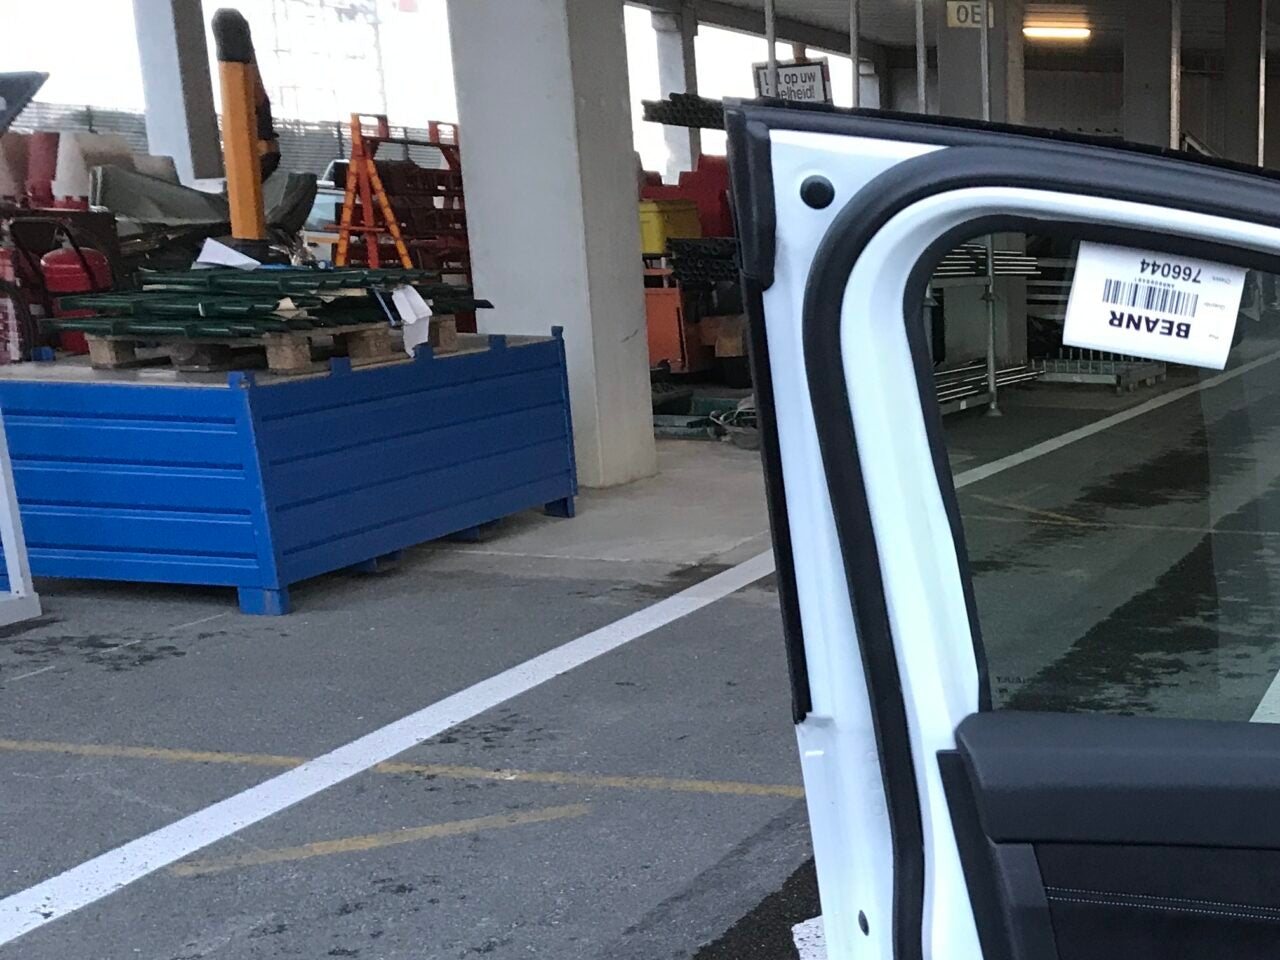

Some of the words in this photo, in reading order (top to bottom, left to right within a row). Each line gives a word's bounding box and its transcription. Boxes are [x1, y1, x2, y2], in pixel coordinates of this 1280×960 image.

[784, 73, 798, 88] op
[800, 72, 816, 83] uw
[1139, 258, 1203, 284] 766044
[1108, 310, 1192, 340] BEANR
